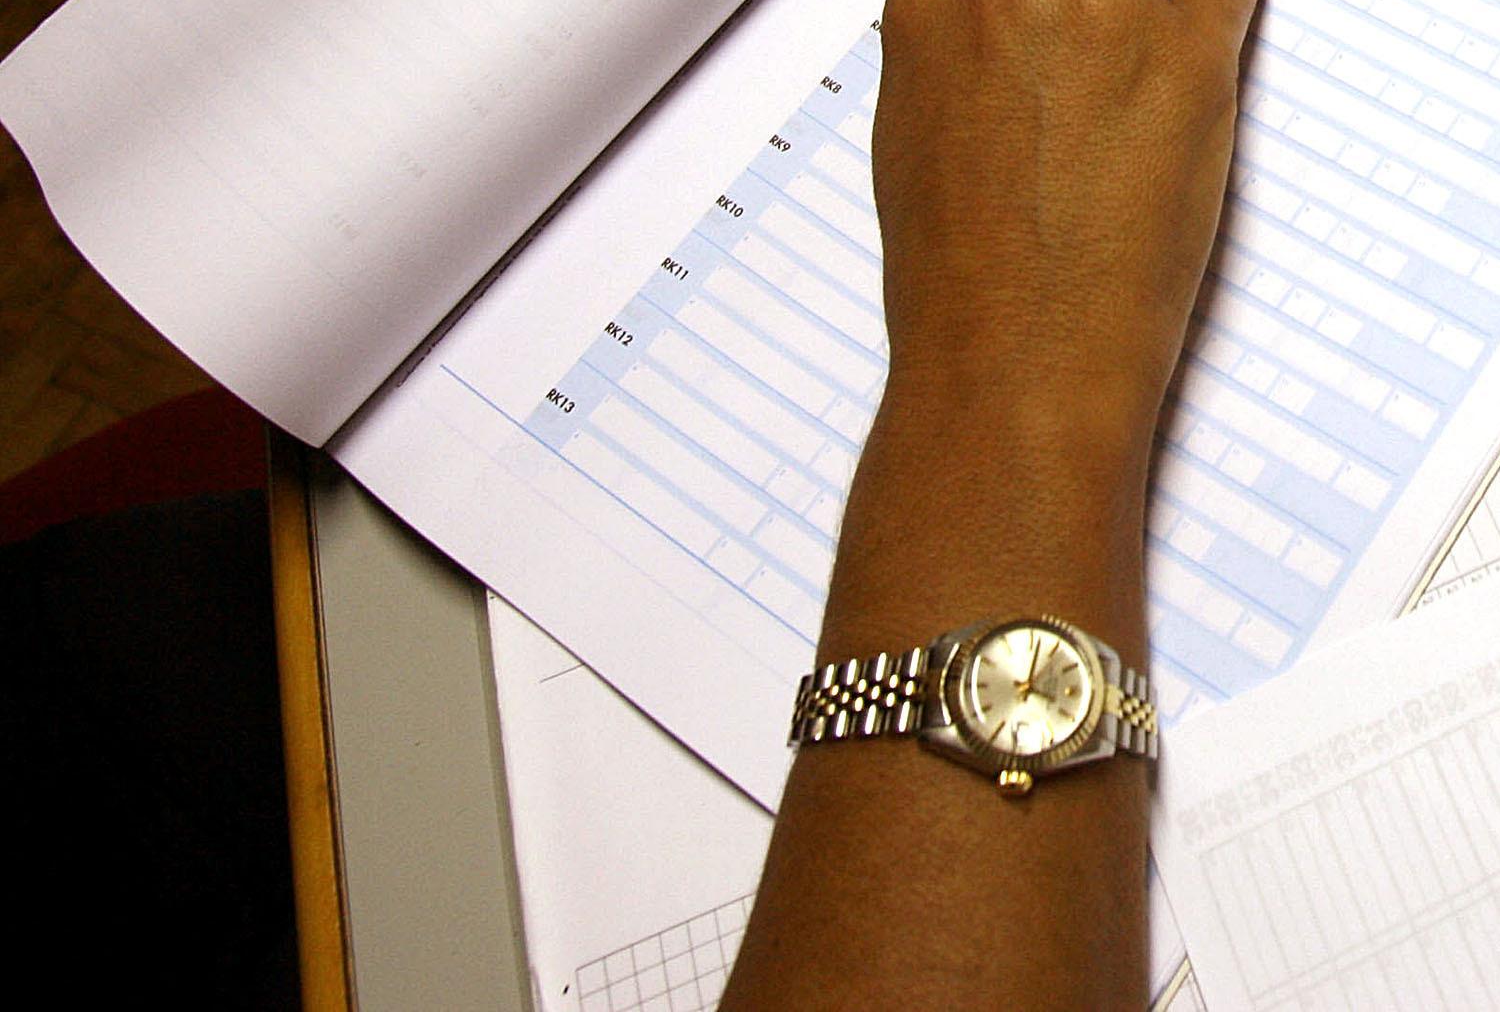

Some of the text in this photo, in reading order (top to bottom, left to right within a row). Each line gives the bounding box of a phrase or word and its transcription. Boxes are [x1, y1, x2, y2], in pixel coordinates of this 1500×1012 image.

[820, 75, 842, 95] RK8
[768, 133, 792, 154] RK9
[715, 194, 745, 219] RK10
[660, 256, 690, 282] RK11
[604, 321, 634, 347] RK12
[545, 387, 576, 414] RK13
